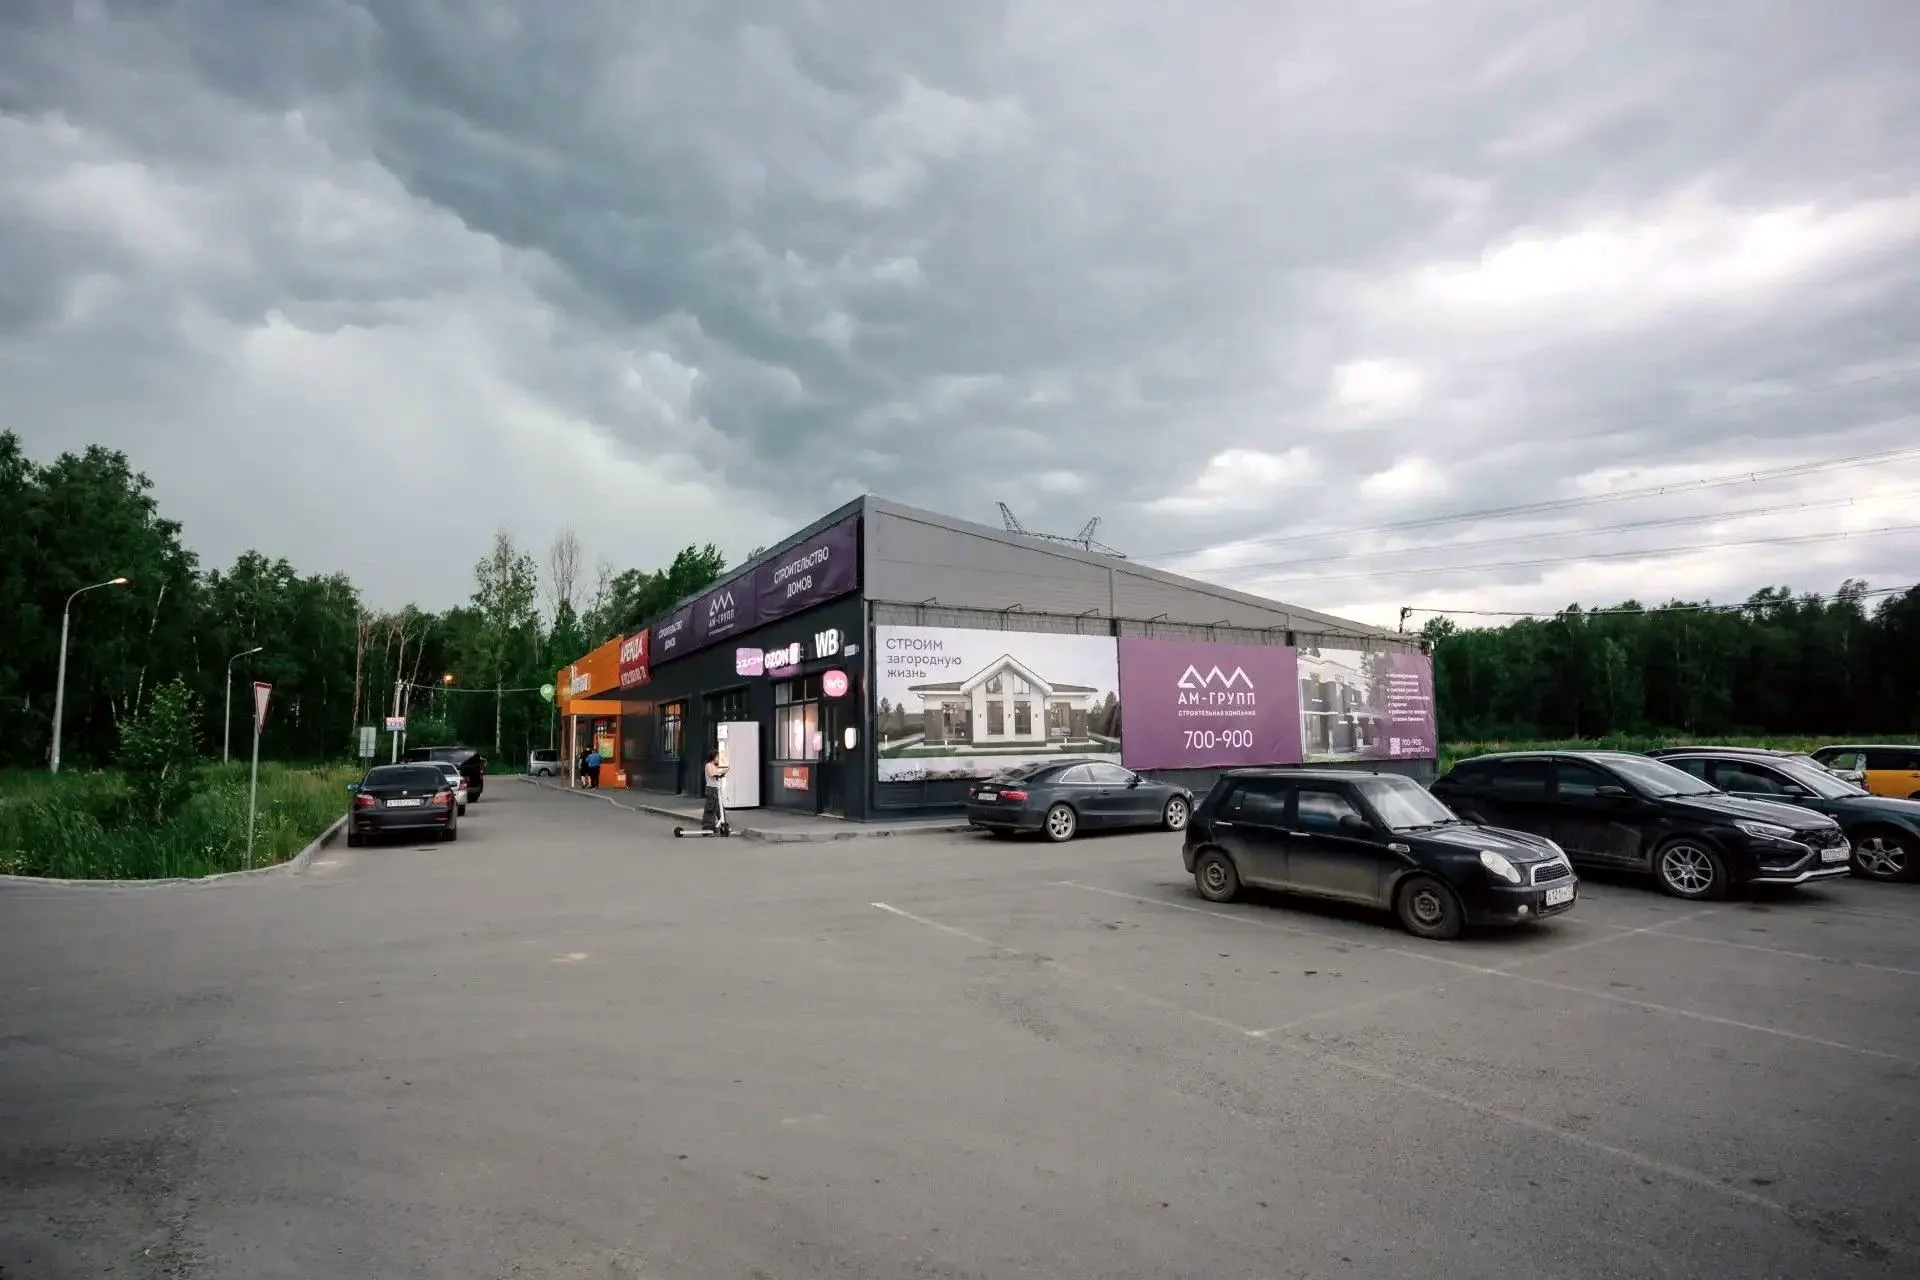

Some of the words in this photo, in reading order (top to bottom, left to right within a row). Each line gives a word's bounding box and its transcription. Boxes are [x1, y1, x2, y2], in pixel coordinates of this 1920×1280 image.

[774, 546, 829, 584] СТРОИТЕЛЬСТВО
[786, 575, 813, 599] ДОМОВ
[815, 628, 840, 659] WB
[886, 638, 943, 650] СТРОИМ
[886, 655, 962, 668] загородную
[887, 669, 927, 678] жизнь
[1178, 692, 1255, 705] АМ-ГРУПП
[1184, 729, 1253, 749] 700-900
